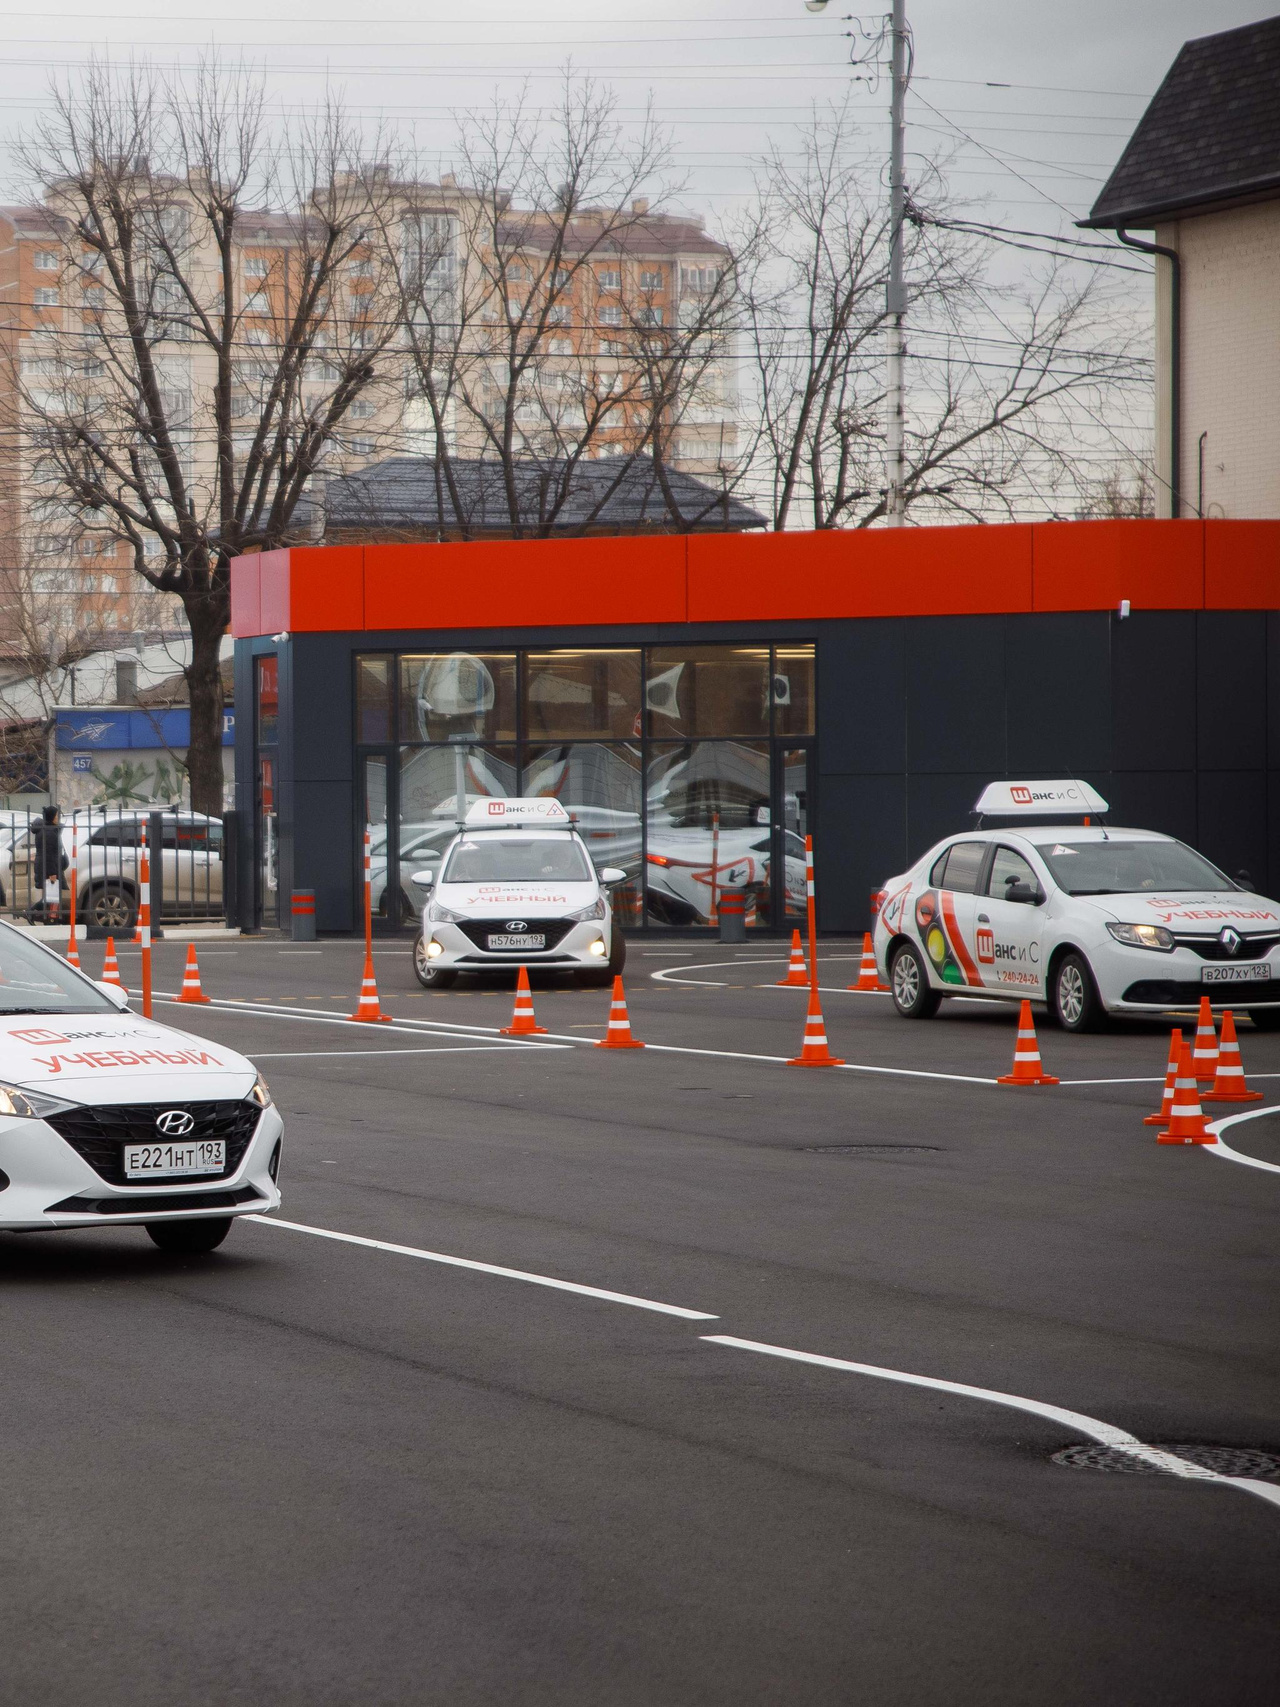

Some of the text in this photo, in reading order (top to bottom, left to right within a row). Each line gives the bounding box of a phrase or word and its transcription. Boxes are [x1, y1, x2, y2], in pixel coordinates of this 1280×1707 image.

[74, 758, 91, 769] 457
[1010, 786, 1055, 804] Шанс
[1067, 789, 1078, 799] С
[488, 802, 525, 815] Шанс
[537, 804, 546, 813] С
[467, 894, 568, 905] УЧЕБНЫЙ
[1156, 909, 1278, 922] УЧЕБНЫЙ
[491, 933, 544, 946] Н576НУ 193
[977, 928, 1039, 964] Шанс и С
[1003, 970, 1039, 985] 240-24-24
[1207, 966, 1267, 980] В207ХУ 123
[7, 1028, 116, 1046] Шанс
[32, 1049, 224, 1073] УЧЕБНЫЙ
[130, 1142, 222, 1170] Е221НТ 193
